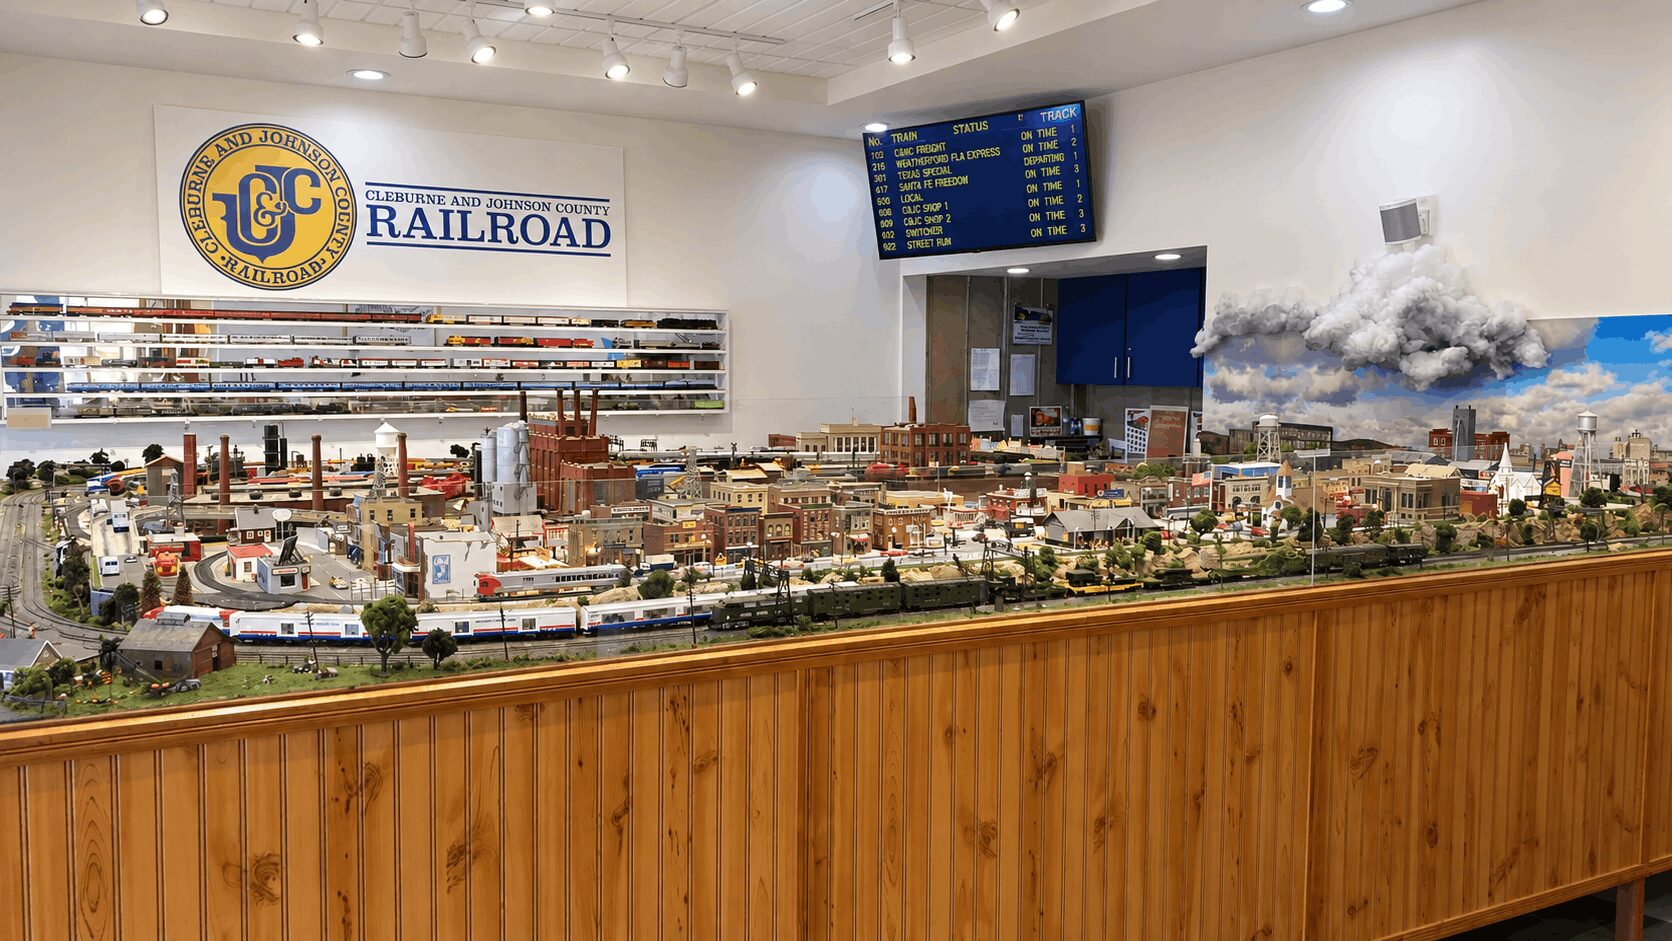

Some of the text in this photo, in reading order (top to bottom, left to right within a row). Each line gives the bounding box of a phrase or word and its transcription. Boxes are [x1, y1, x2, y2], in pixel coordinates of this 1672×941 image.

[891, 131, 918, 143] TRAIN
[953, 120, 988, 134] STATUS
[1040, 108, 1077, 122] TRACK
[916, 142, 946, 154] FREIGHT
[1021, 131, 1032, 140] ON
[1036, 127, 1058, 138] TIME
[966, 147, 1000, 160] EXPRESS
[1022, 144, 1034, 153] ON
[1038, 140, 1058, 151] TIME
[1071, 138, 1076, 146] 2
[897, 170, 920, 180] TEXAS
[922, 166, 952, 177] SPECIAL
[1024, 152, 1065, 166] DEPARTING
[899, 182, 922, 192] SANTA
[924, 180, 933, 189] FE
[935, 176, 968, 187] FREEDOM
[1025, 170, 1036, 179] ON
[1041, 166, 1061, 177] TIME
[1074, 164, 1079, 173] 3
[187, 130, 348, 262] CLEBURNE AND JOHNSON COUNTY
[365, 189, 610, 216] CLEBURNE AND JOHNSON COUNTY
[900, 194, 924, 203] LOCAL
[1026, 184, 1038, 193] ON
[1043, 181, 1062, 192] TIME
[923, 202, 942, 212] SHOP
[1028, 198, 1039, 207] ON
[1044, 195, 1064, 206] TIME
[1078, 194, 1083, 203] 2
[366, 204, 612, 249] RAILROAD
[925, 214, 944, 224] SHOP
[946, 214, 951, 222] 2
[1029, 213, 1040, 222] ON
[1046, 210, 1066, 220] TIME
[1079, 209, 1084, 218] 3
[906, 226, 943, 238] SWITCHER
[1031, 228, 1042, 238] ON
[1047, 226, 1068, 236] TIME
[1081, 224, 1086, 233] 3
[907, 239, 933, 249] STREET
[937, 237, 952, 247] RUN
[225, 253, 325, 284] RAILROAD
